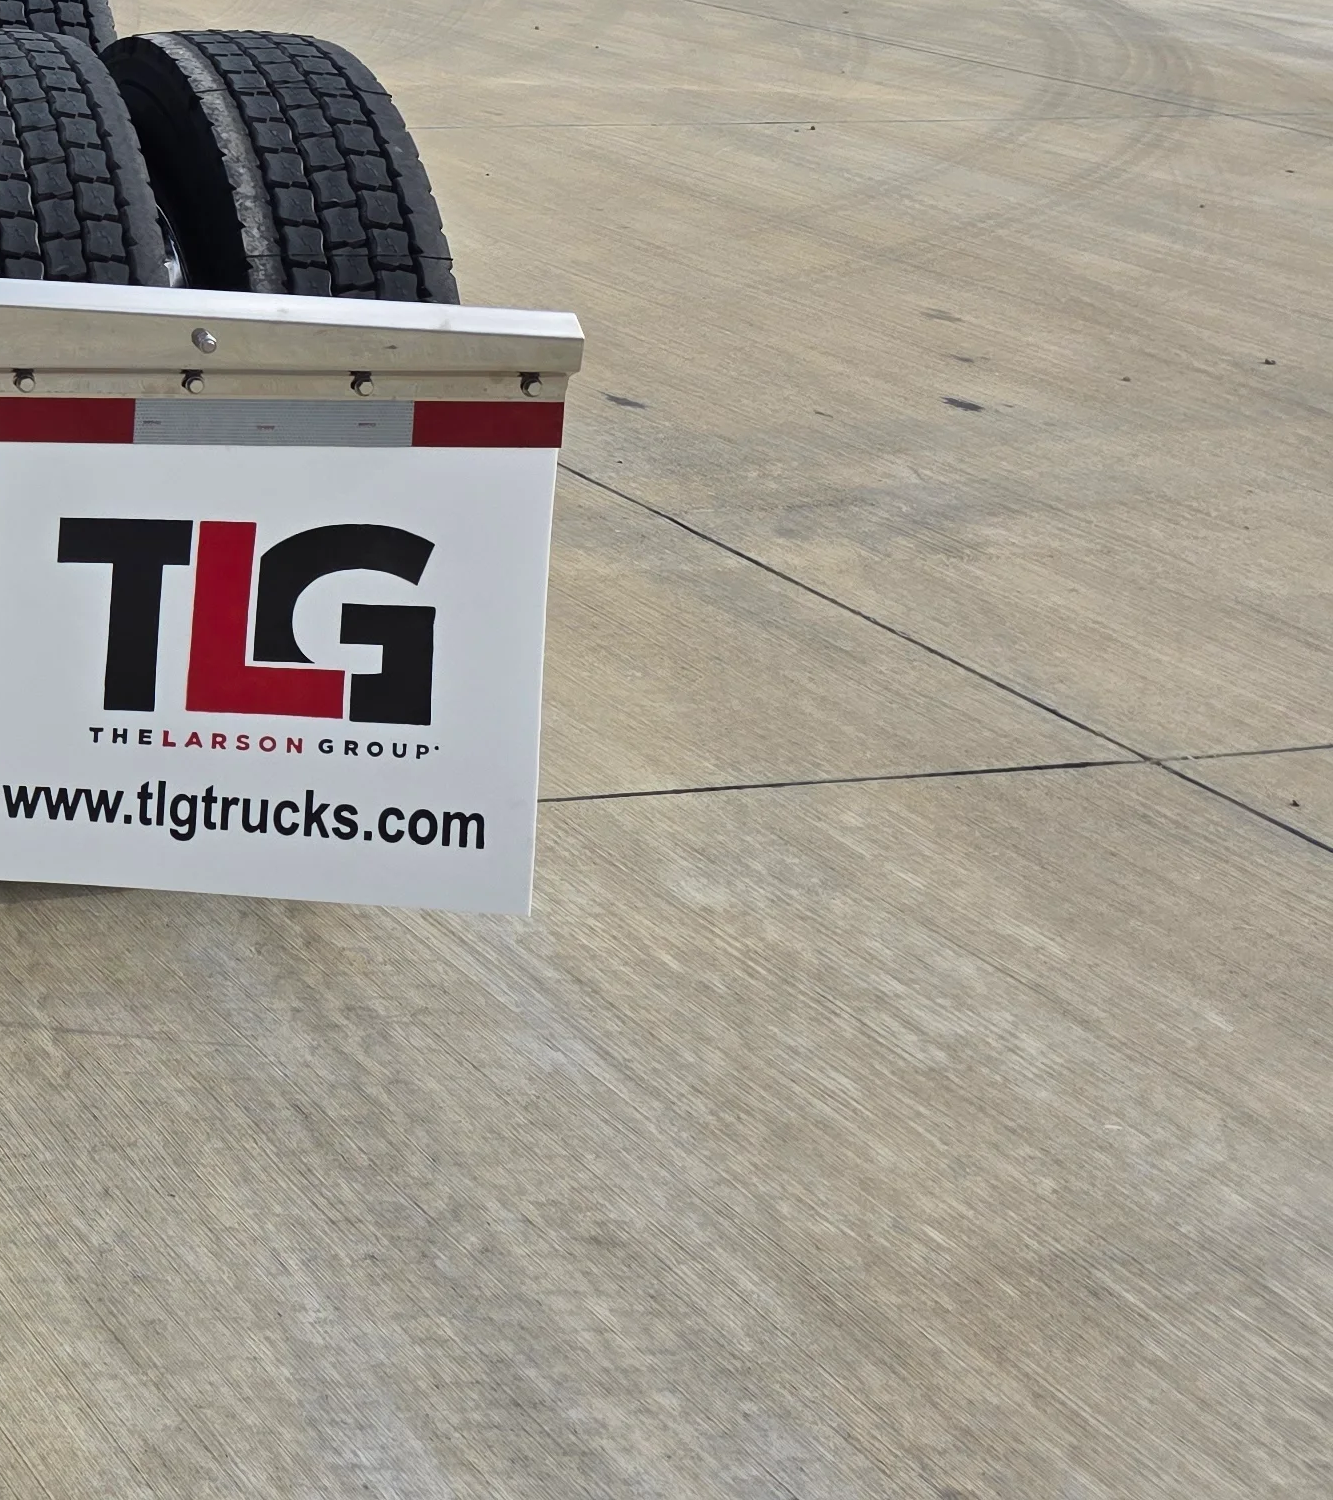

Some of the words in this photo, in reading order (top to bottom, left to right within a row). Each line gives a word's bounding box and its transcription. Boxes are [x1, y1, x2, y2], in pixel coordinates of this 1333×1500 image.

[56, 516, 437, 727] TLG
[317, 738, 431, 760] GROUP
[2, 780, 486, 851] www.tlgtrucks.com
